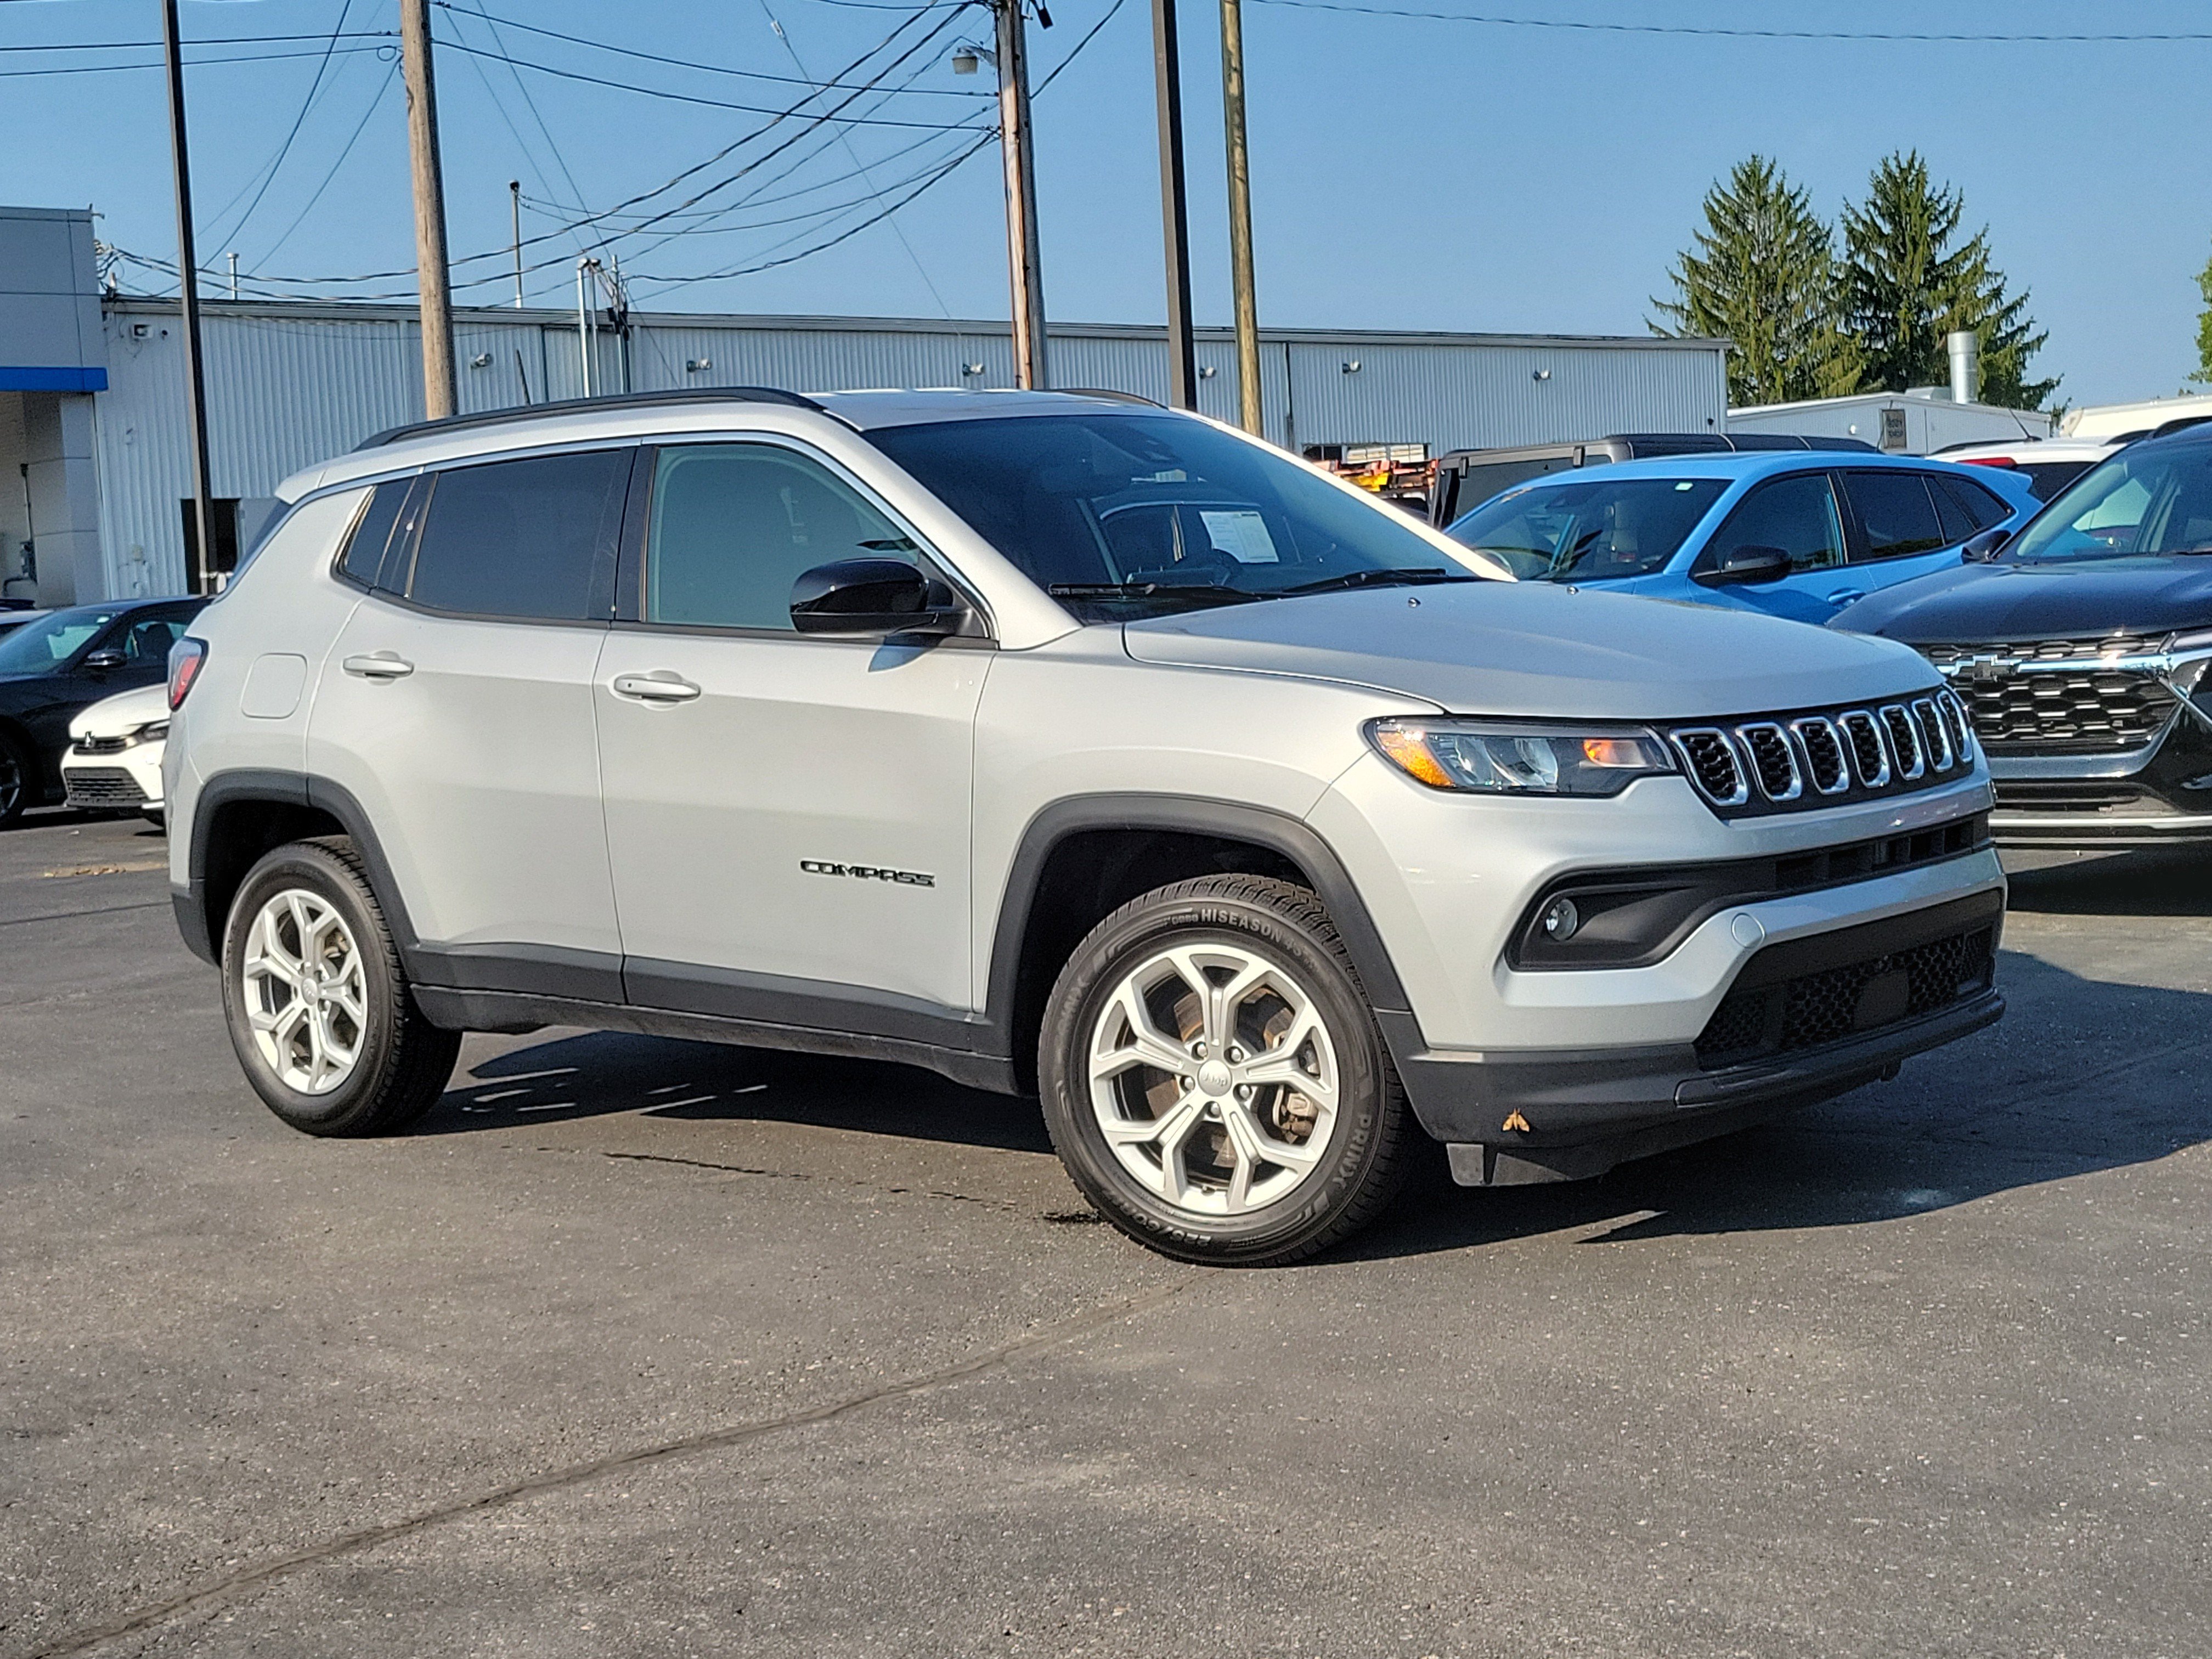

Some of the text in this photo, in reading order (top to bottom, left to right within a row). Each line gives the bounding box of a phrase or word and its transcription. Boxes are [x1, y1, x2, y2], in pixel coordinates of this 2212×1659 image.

[800, 860, 935, 888] COMPASS
[1201, 909, 1283, 943] HISEASON
[1332, 1114, 1372, 1189] PRINX
